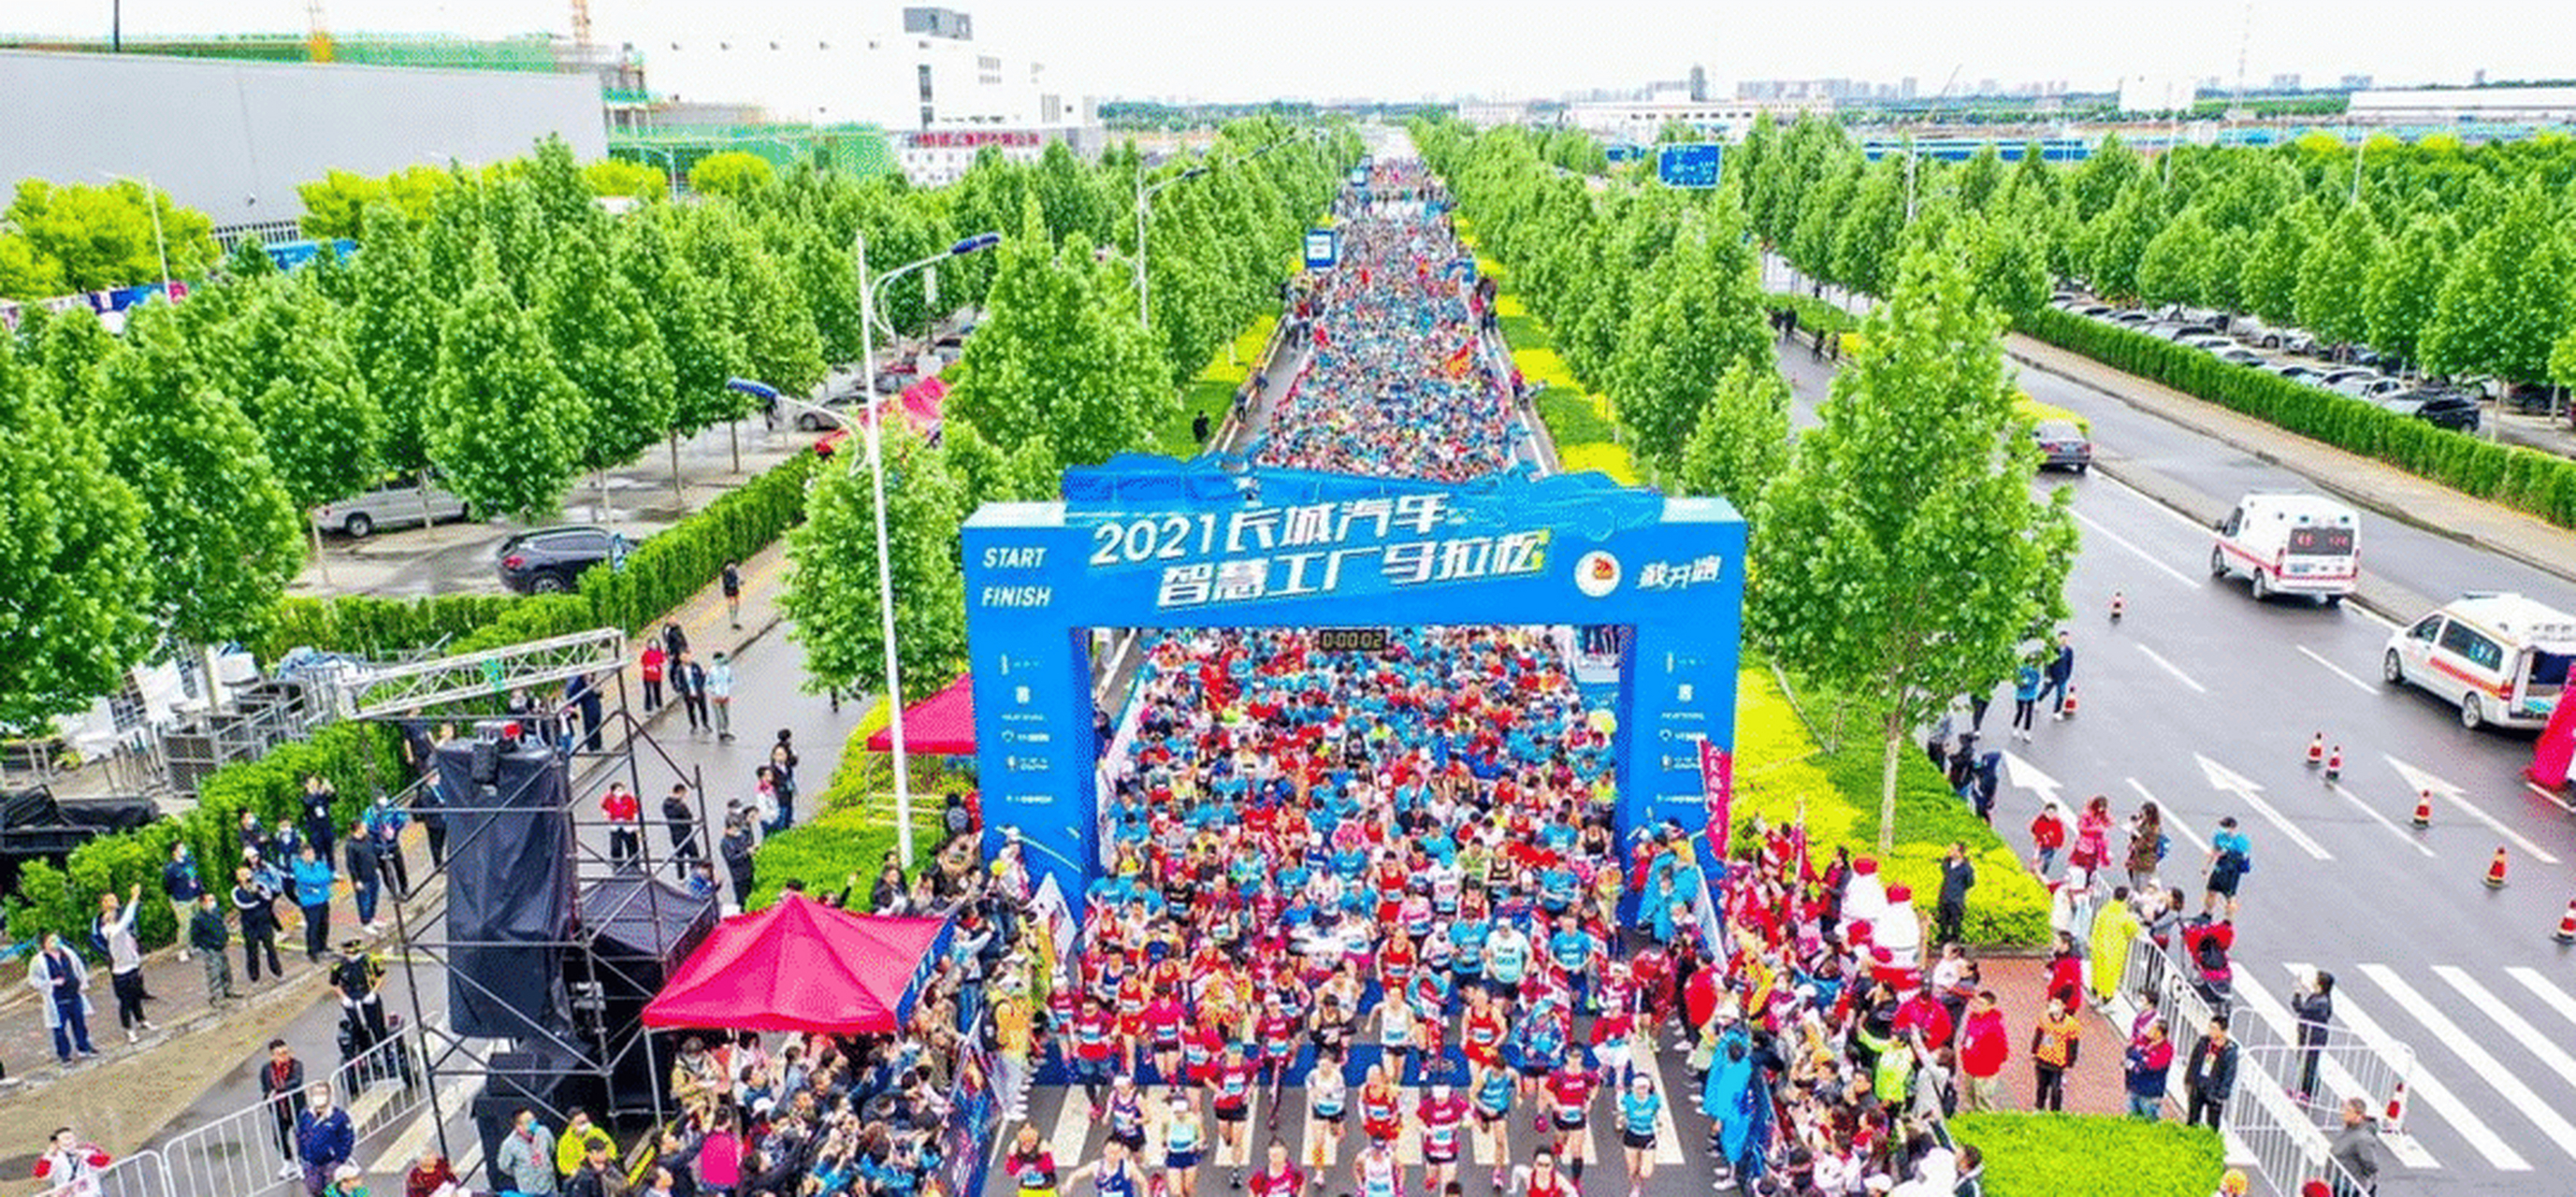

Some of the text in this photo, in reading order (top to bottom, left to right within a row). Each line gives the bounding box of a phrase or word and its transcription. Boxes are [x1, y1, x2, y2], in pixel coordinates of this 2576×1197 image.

[1090, 493, 1451, 566] 2021长城汽车
[983, 547, 1047, 568] START
[1156, 528, 1552, 608] 智慧工厂马拉松
[982, 586, 1051, 607] FINISH
